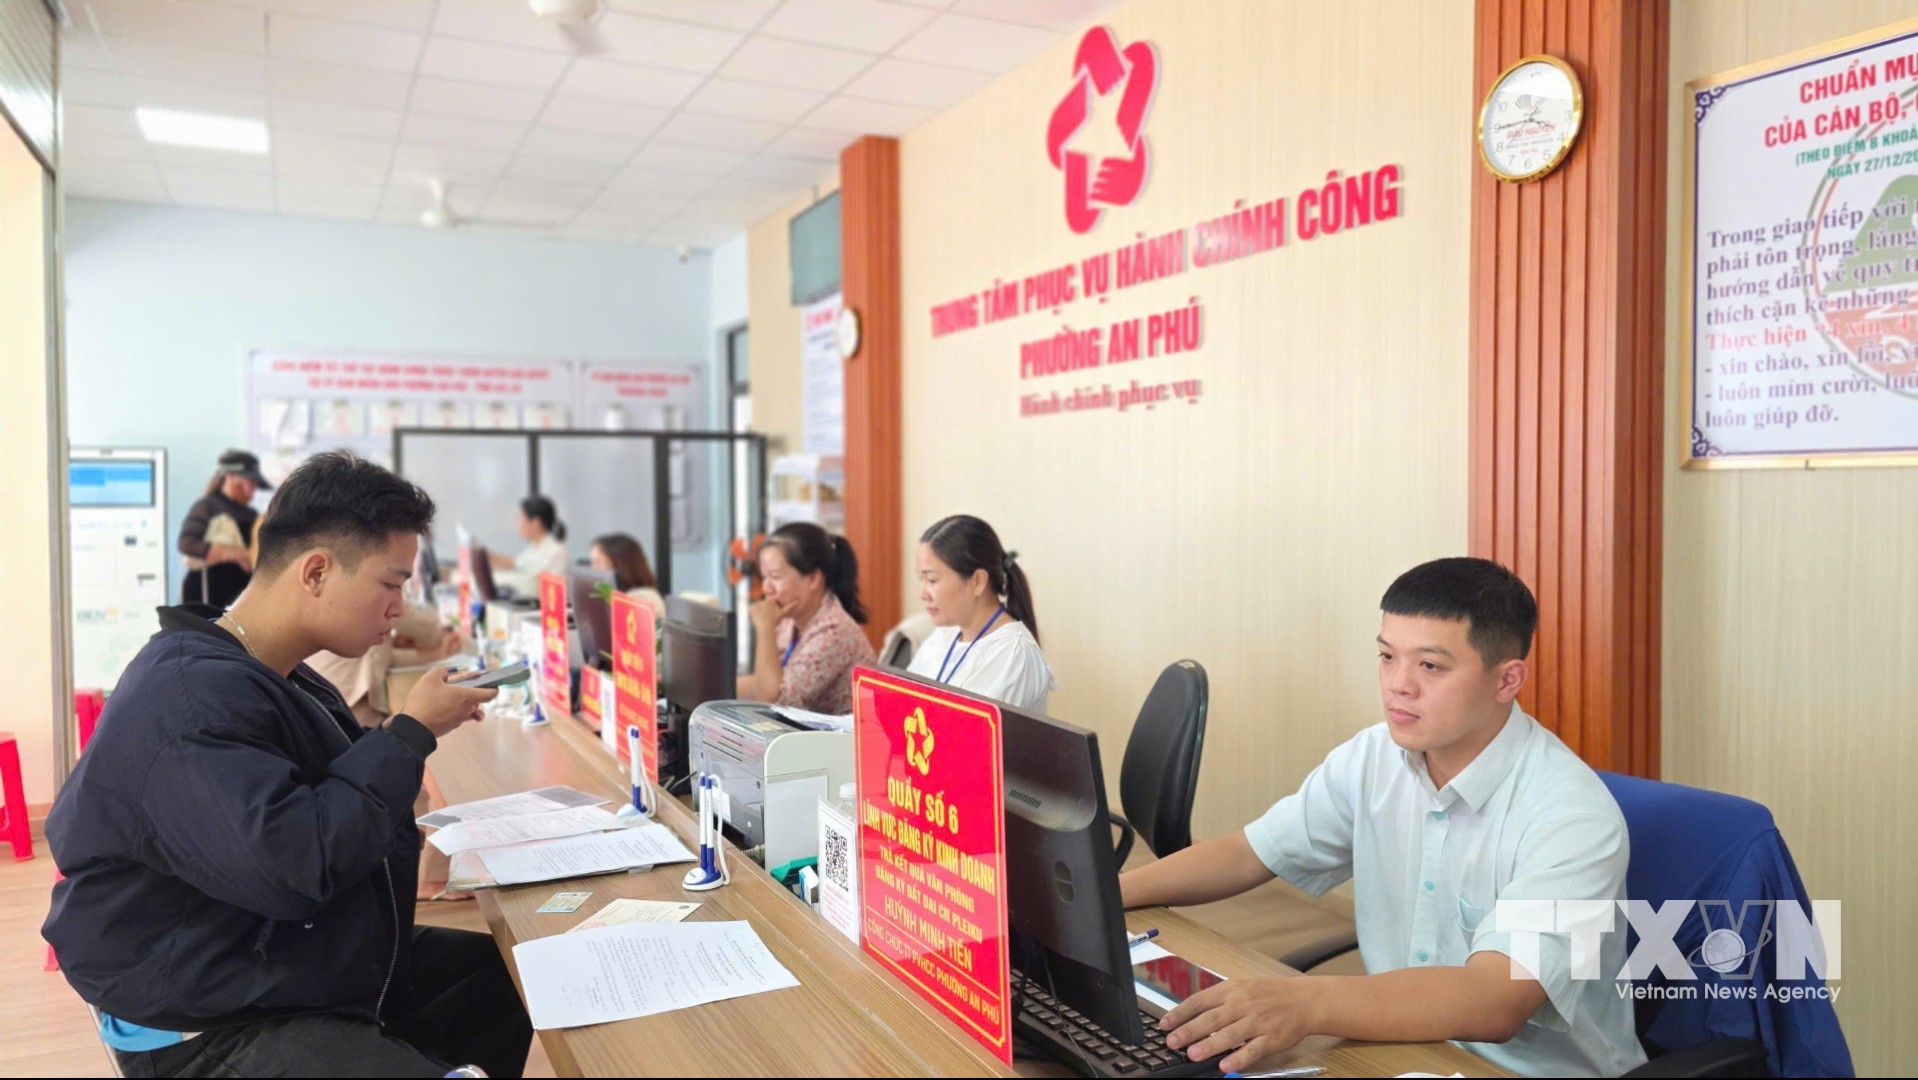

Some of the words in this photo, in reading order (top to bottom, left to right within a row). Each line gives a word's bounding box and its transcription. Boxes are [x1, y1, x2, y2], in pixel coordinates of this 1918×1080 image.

[1799, 59, 1876, 104] CHUẨN
[1765, 116, 1807, 148] CỦA
[1814, 105, 1861, 137] CÁN
[1868, 91, 1907, 125] BỘ,
[1870, 136, 1878, 150] B
[1708, 226, 1765, 250] Trong
[1772, 217, 1815, 241] giao
[1823, 201, 1864, 230] tiếp
[930, 293, 979, 339] TRUNG
[982, 278, 1019, 325] TÂM
[1023, 263, 1077, 316] PHỤC
[1082, 252, 1110, 304] VỤ
[1116, 231, 1185, 290] HÀNH
[1192, 199, 1285, 268] CHÍNH
[1296, 164, 1399, 241] CÔNG
[1706, 251, 1750, 280] phải
[1756, 247, 1788, 268] tôn
[1706, 278, 1770, 301] hướng
[1776, 266, 1814, 289] dẫn
[1853, 262, 1893, 285] quy
[1706, 303, 1754, 326] thích
[1761, 301, 1797, 322] cặn
[1837, 287, 1910, 311] những
[1020, 324, 1101, 380] PHƯỜNG
[1107, 318, 1140, 365] AN
[1147, 297, 1201, 358] PHÚ
[1706, 331, 1757, 353] Thực
[1763, 324, 1807, 348] hiện
[1719, 358, 1748, 376] xin
[1755, 352, 1809, 373] chào,
[1817, 348, 1849, 368] xin
[1064, 384, 1113, 413] chính
[1118, 379, 1168, 412] phục
[1171, 378, 1201, 405] vụ
[1718, 382, 1761, 402] luôn
[1705, 409, 1748, 429] luôn
[1753, 406, 1799, 430] giúp
[1805, 404, 1840, 423] đỡ.
[925, 790, 945, 828] SỐ
[948, 804, 960, 835] 6
[880, 845, 894, 864] TRẢ
[894, 852, 909, 873] KẾT
[909, 861, 926, 884] QUẢ
[898, 816, 922, 856] ĐĂNG
[922, 829, 935, 862] KÝ
[936, 838, 960, 876] KINH
[960, 851, 996, 897] DOANH
[875, 863, 895, 890] ĐĂNG
[906, 882, 922, 905] ĐẤT
[938, 903, 951, 923] CN
[952, 911, 983, 944] PLEIKU
[884, 895, 917, 934] HUỲNH
[919, 916, 946, 954] MINH
[947, 935, 973, 972] TIẾN
[867, 917, 885, 941] CÔNG
[885, 928, 905, 955] CHỨC
[912, 950, 936, 978] PVHCC
[936, 966, 969, 1002] PHƯỜNG
[969, 991, 981, 1013] AN
[981, 999, 1000, 1026] PHÚ
